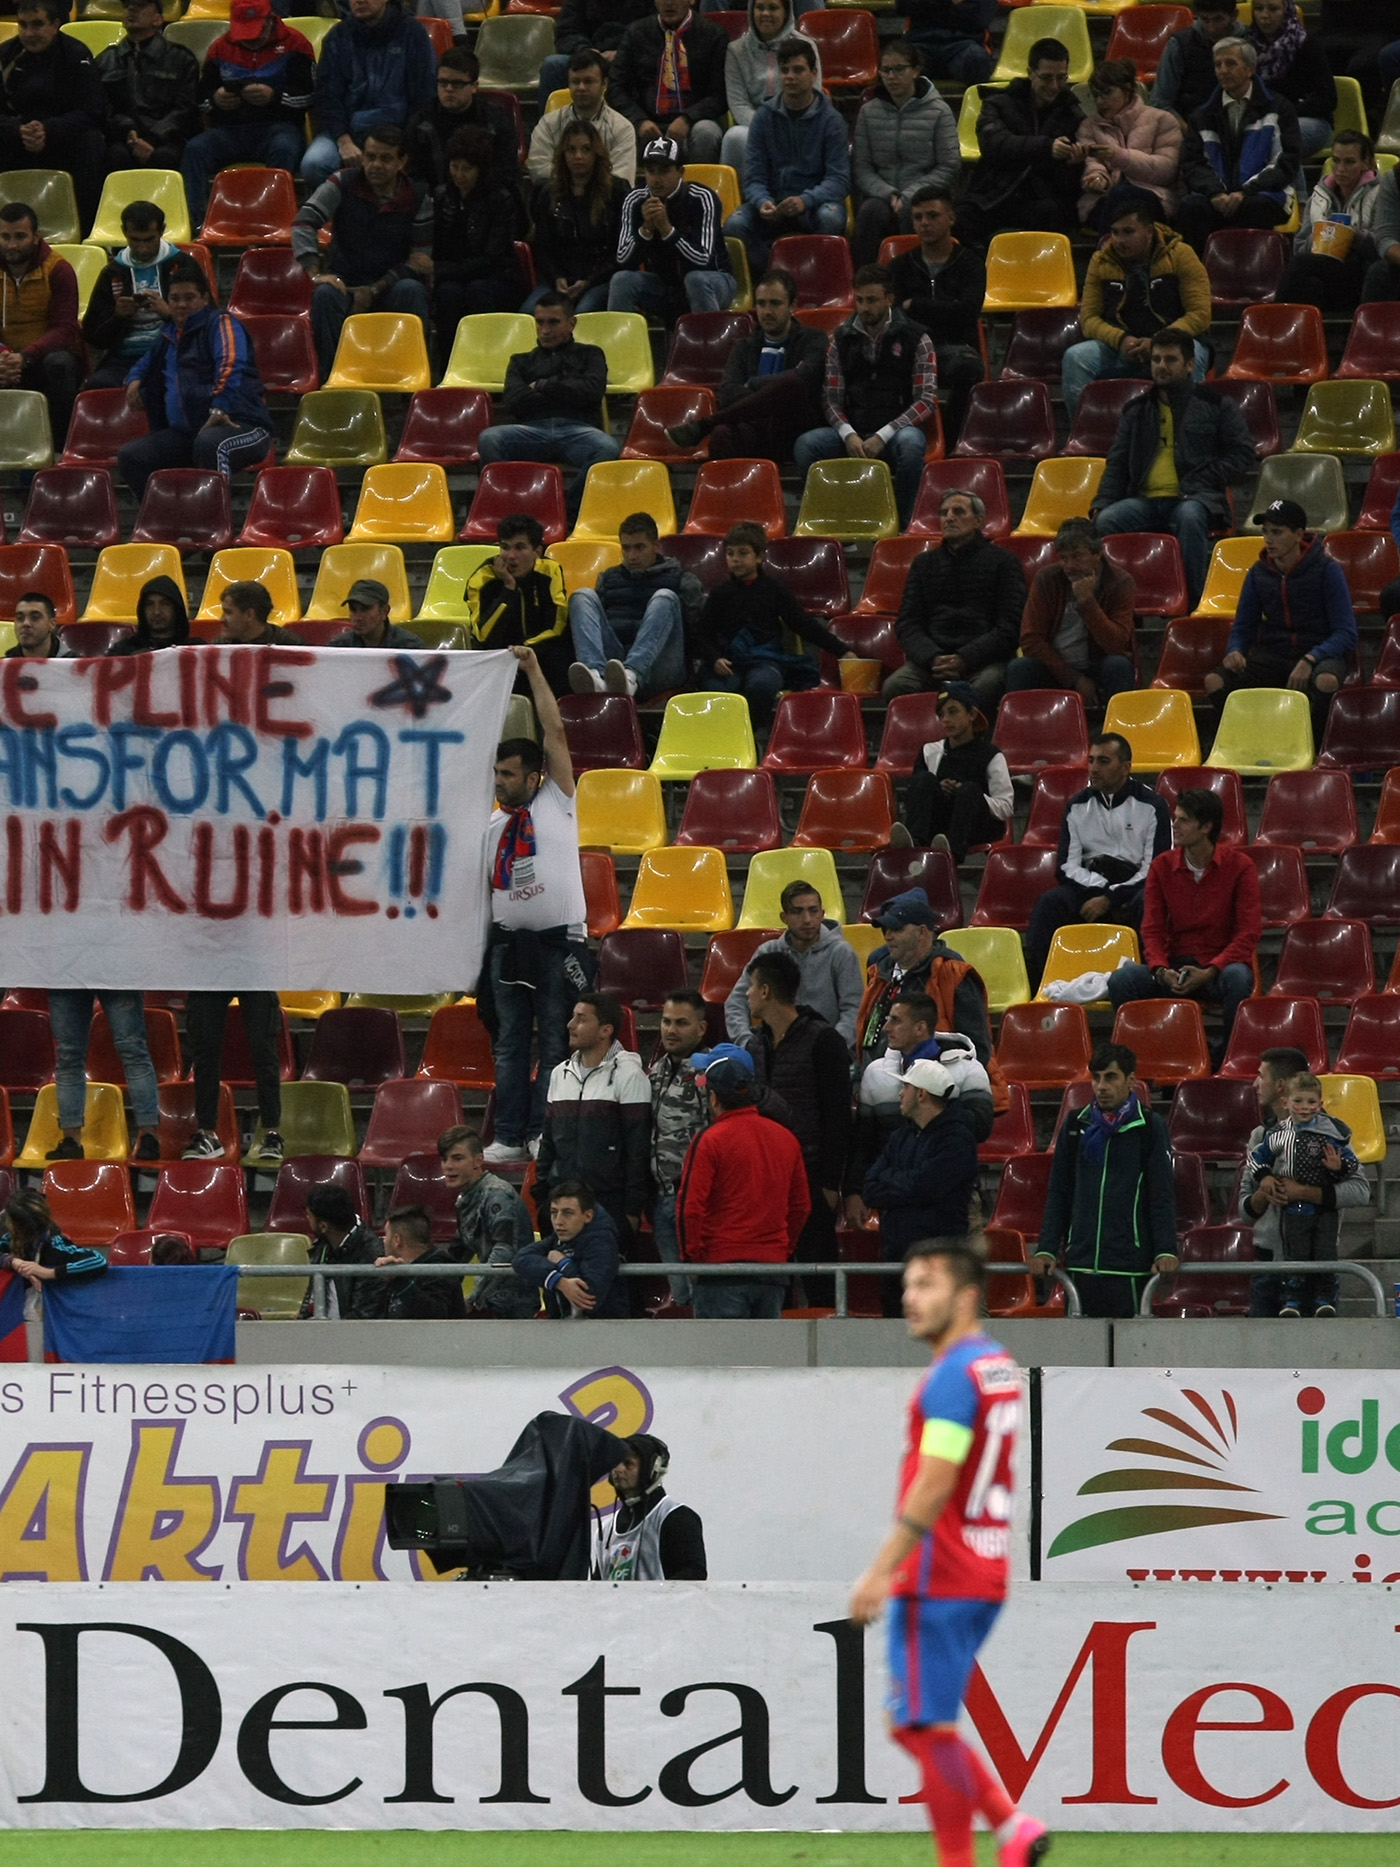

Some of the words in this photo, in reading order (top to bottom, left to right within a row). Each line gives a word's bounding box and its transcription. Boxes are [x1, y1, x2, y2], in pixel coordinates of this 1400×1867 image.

[72, 647, 316, 737] PLINE
[6, 814, 81, 915] IN
[509, 883, 545, 901] URSUS
